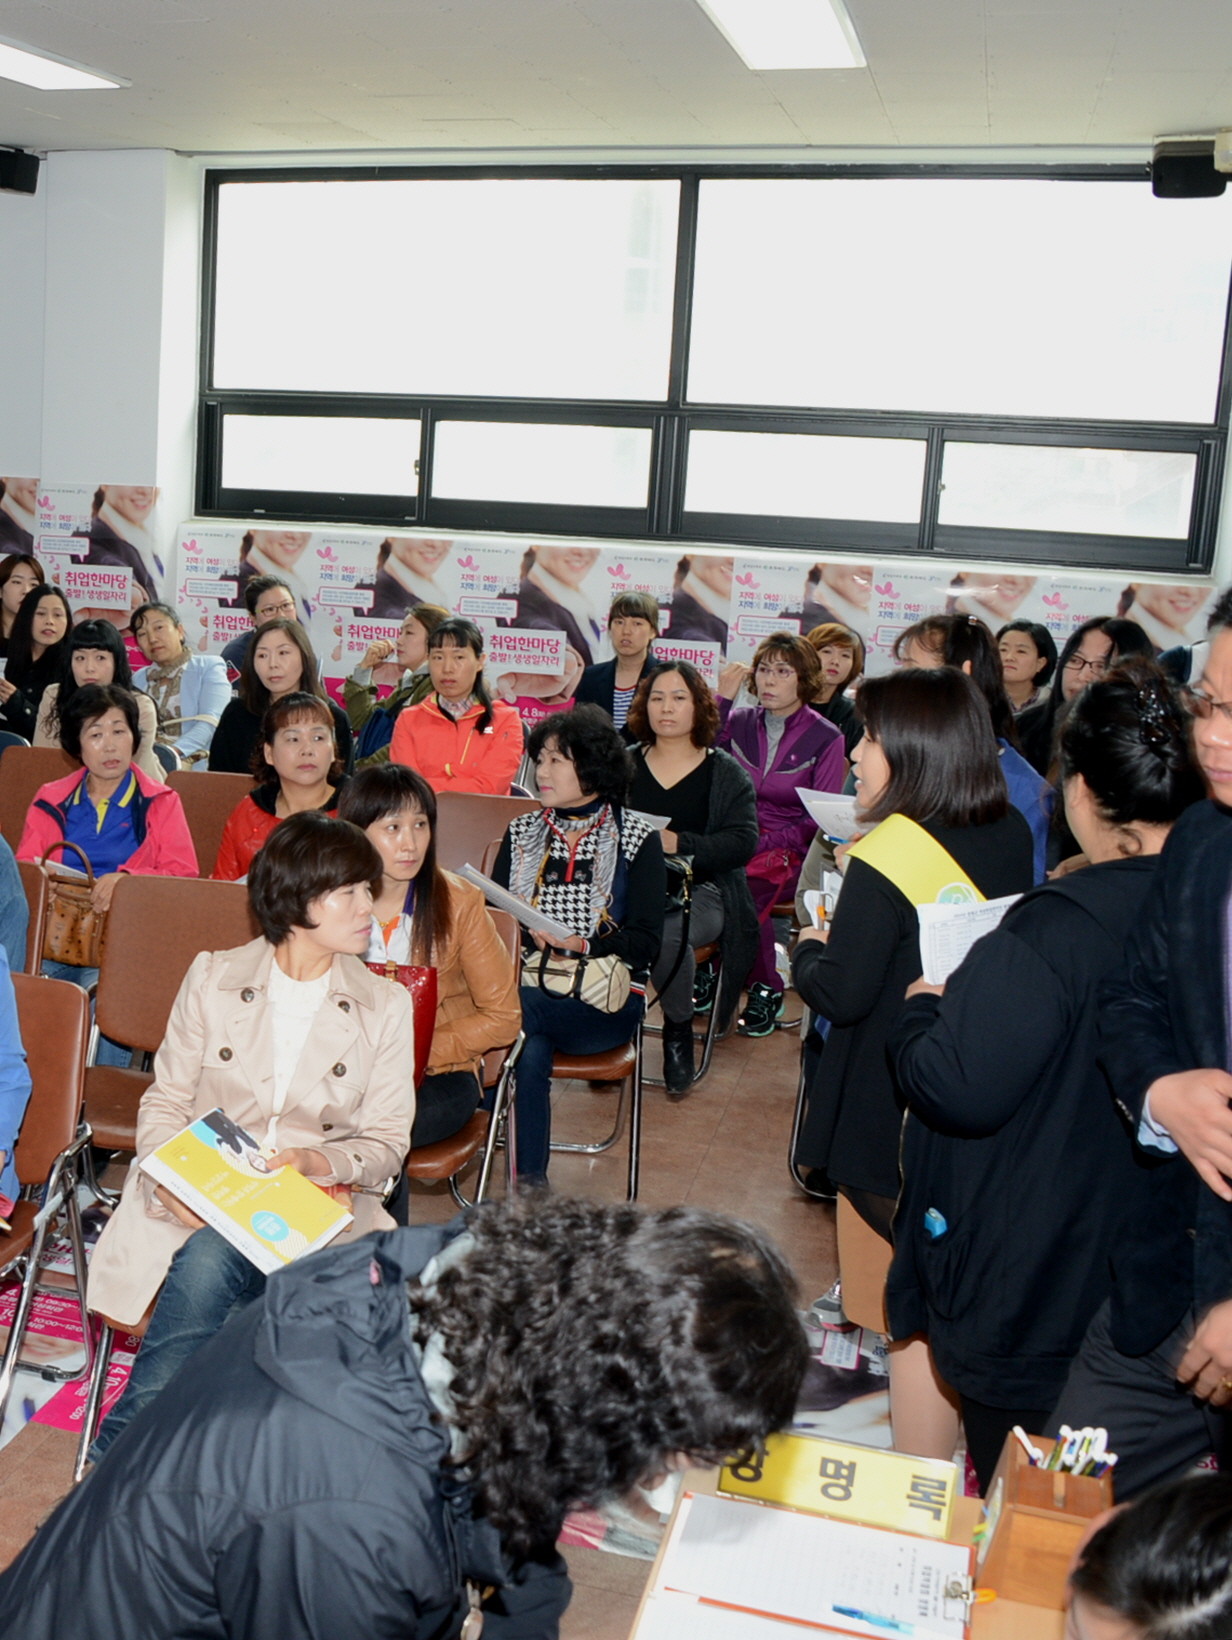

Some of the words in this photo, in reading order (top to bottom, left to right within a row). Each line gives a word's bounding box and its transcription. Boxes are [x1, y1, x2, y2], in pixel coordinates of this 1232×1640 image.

[65, 571, 128, 590] 취업한마당
[489, 634, 561, 655] 취업한마당
[489, 652, 511, 664] 출발!
[513, 653, 560, 667] 생생일자리
[650, 645, 715, 667] 업한마당
